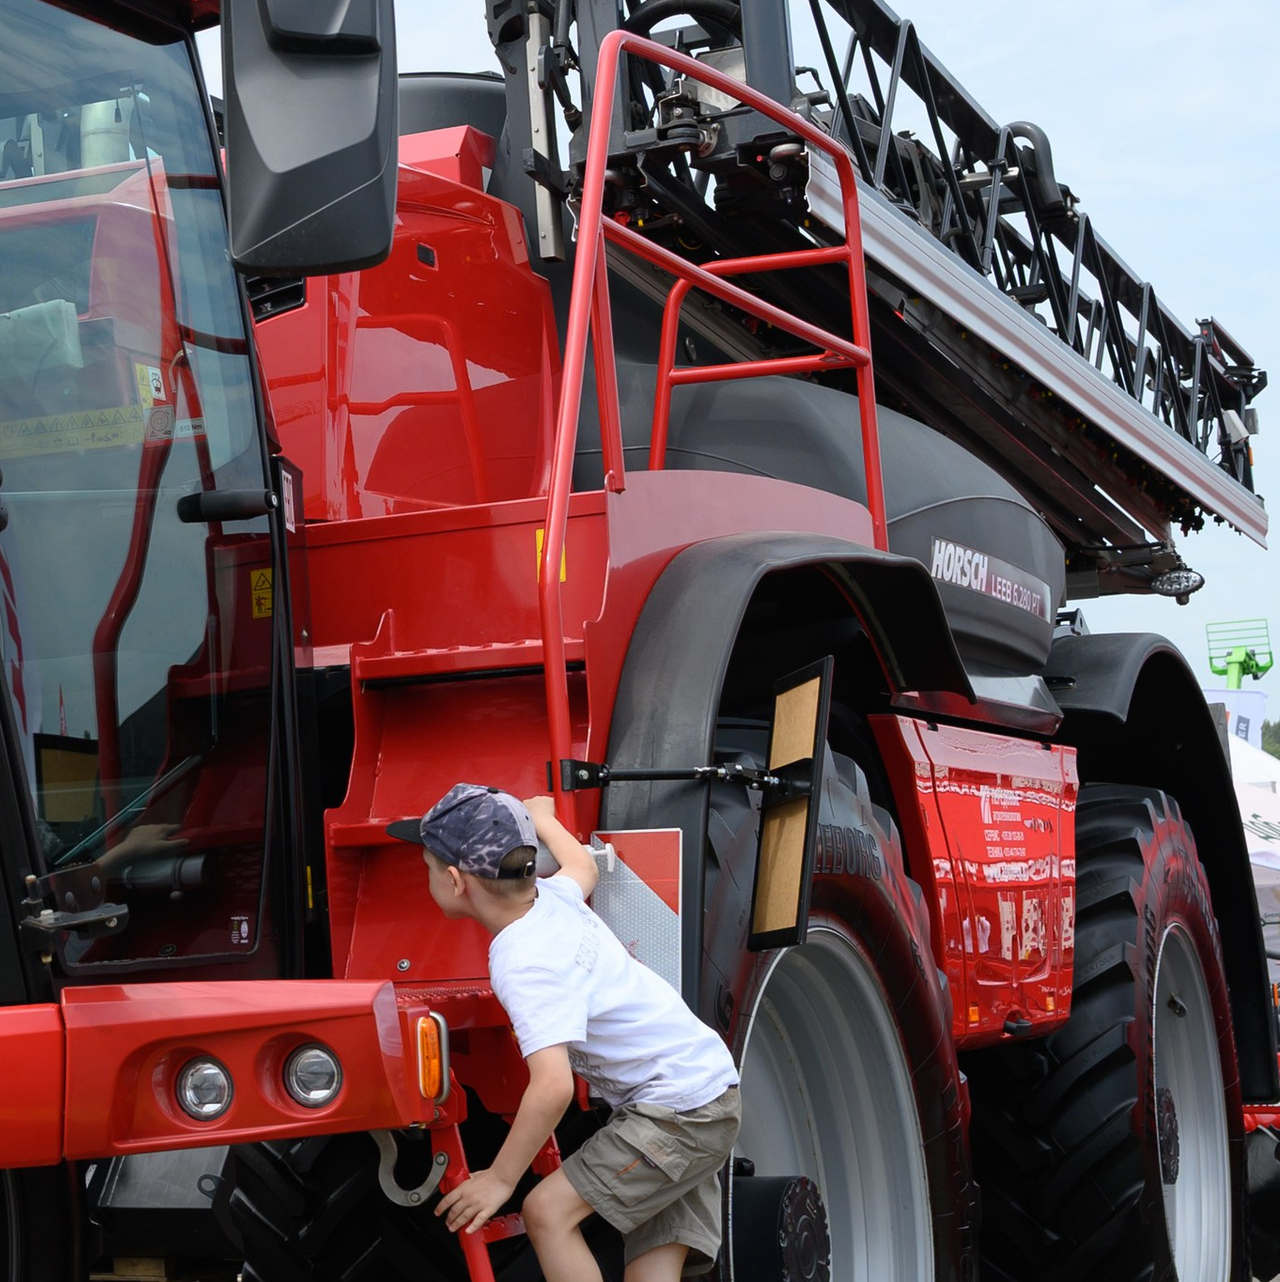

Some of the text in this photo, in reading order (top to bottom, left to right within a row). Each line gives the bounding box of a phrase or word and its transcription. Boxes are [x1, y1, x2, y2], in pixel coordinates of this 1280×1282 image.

[931, 539, 988, 592] HORSCH
[991, 574, 1011, 602] LEEB
[1013, 583, 1031, 611] 6.280
